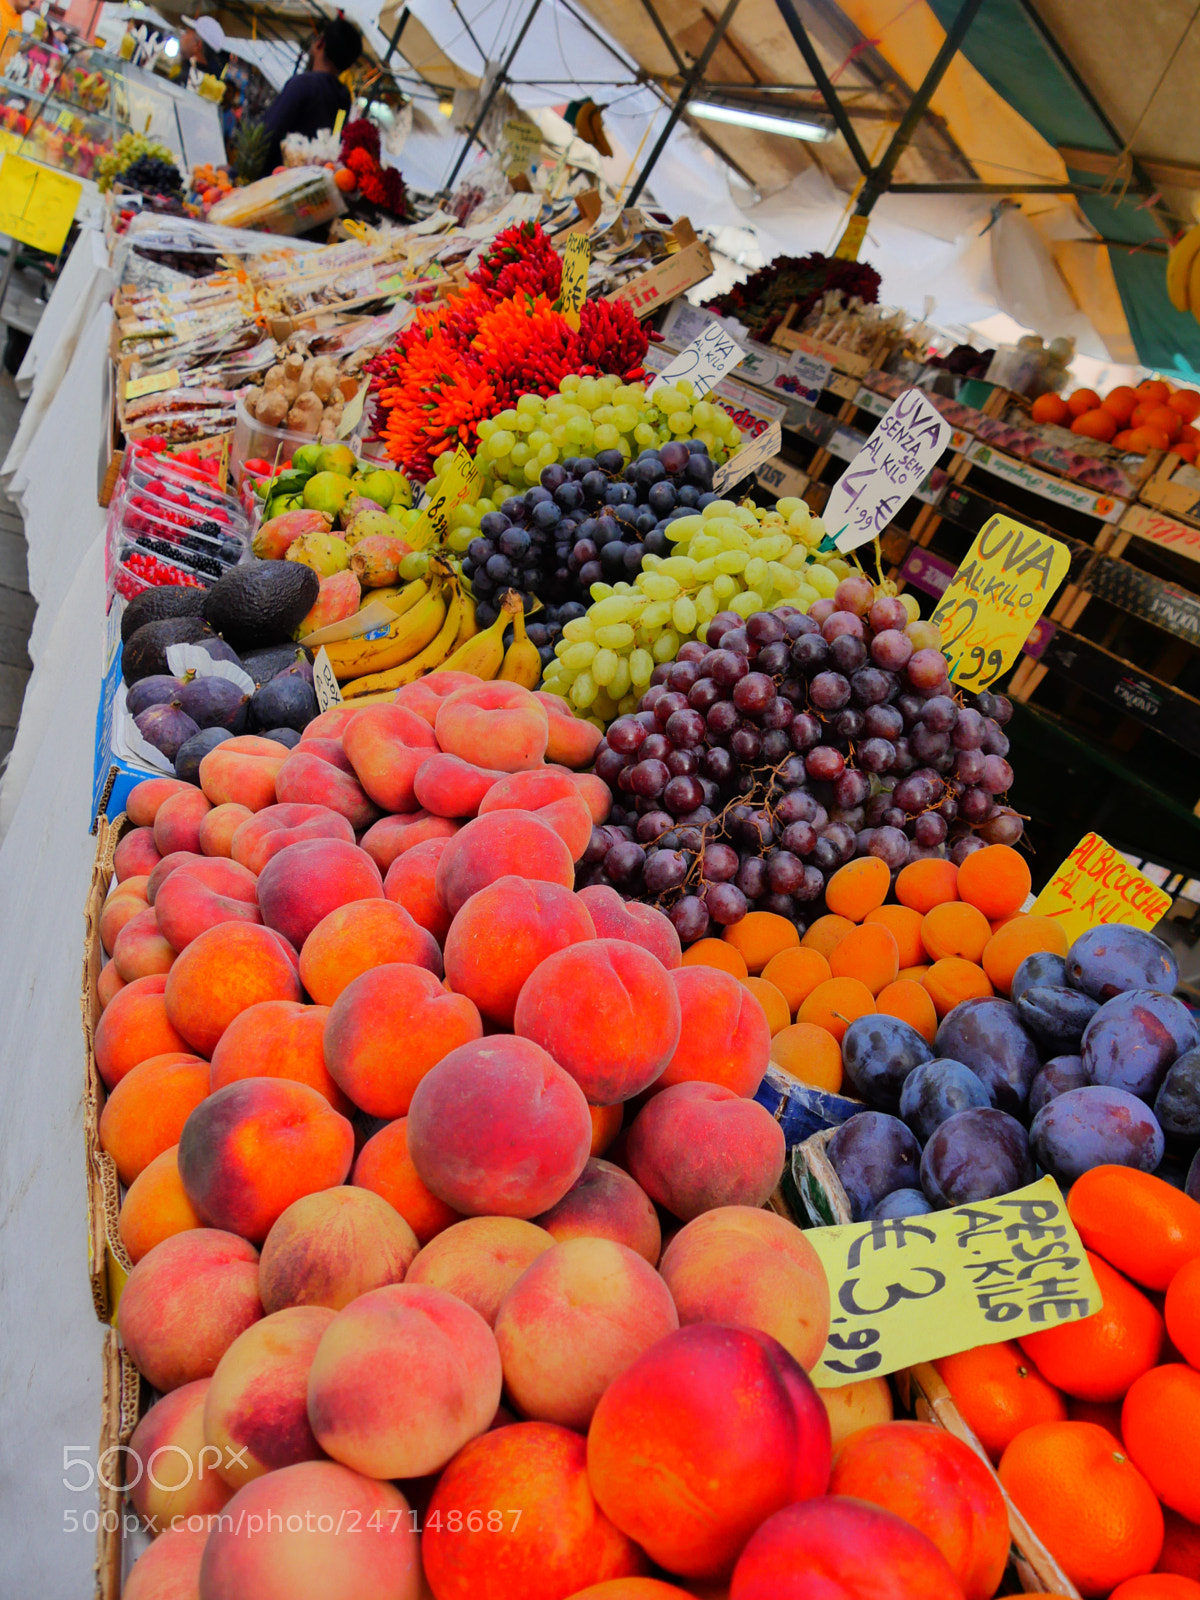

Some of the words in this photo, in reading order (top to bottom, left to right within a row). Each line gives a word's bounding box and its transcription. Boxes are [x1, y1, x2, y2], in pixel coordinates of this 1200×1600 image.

[703, 325, 736, 360] UVA
[704, 350, 726, 372] KILO
[879, 416, 922, 457] SENZA
[895, 389, 942, 450] UVA
[453, 448, 479, 485] FICHI
[879, 453, 908, 485] KILO
[898, 455, 926, 480] SEMI
[978, 518, 1056, 592] UVA
[1067, 832, 1170, 923] ALBICOCCHE
[994, 1199, 1090, 1323] PESCHE
[962, 1258, 1024, 1323] KILO
